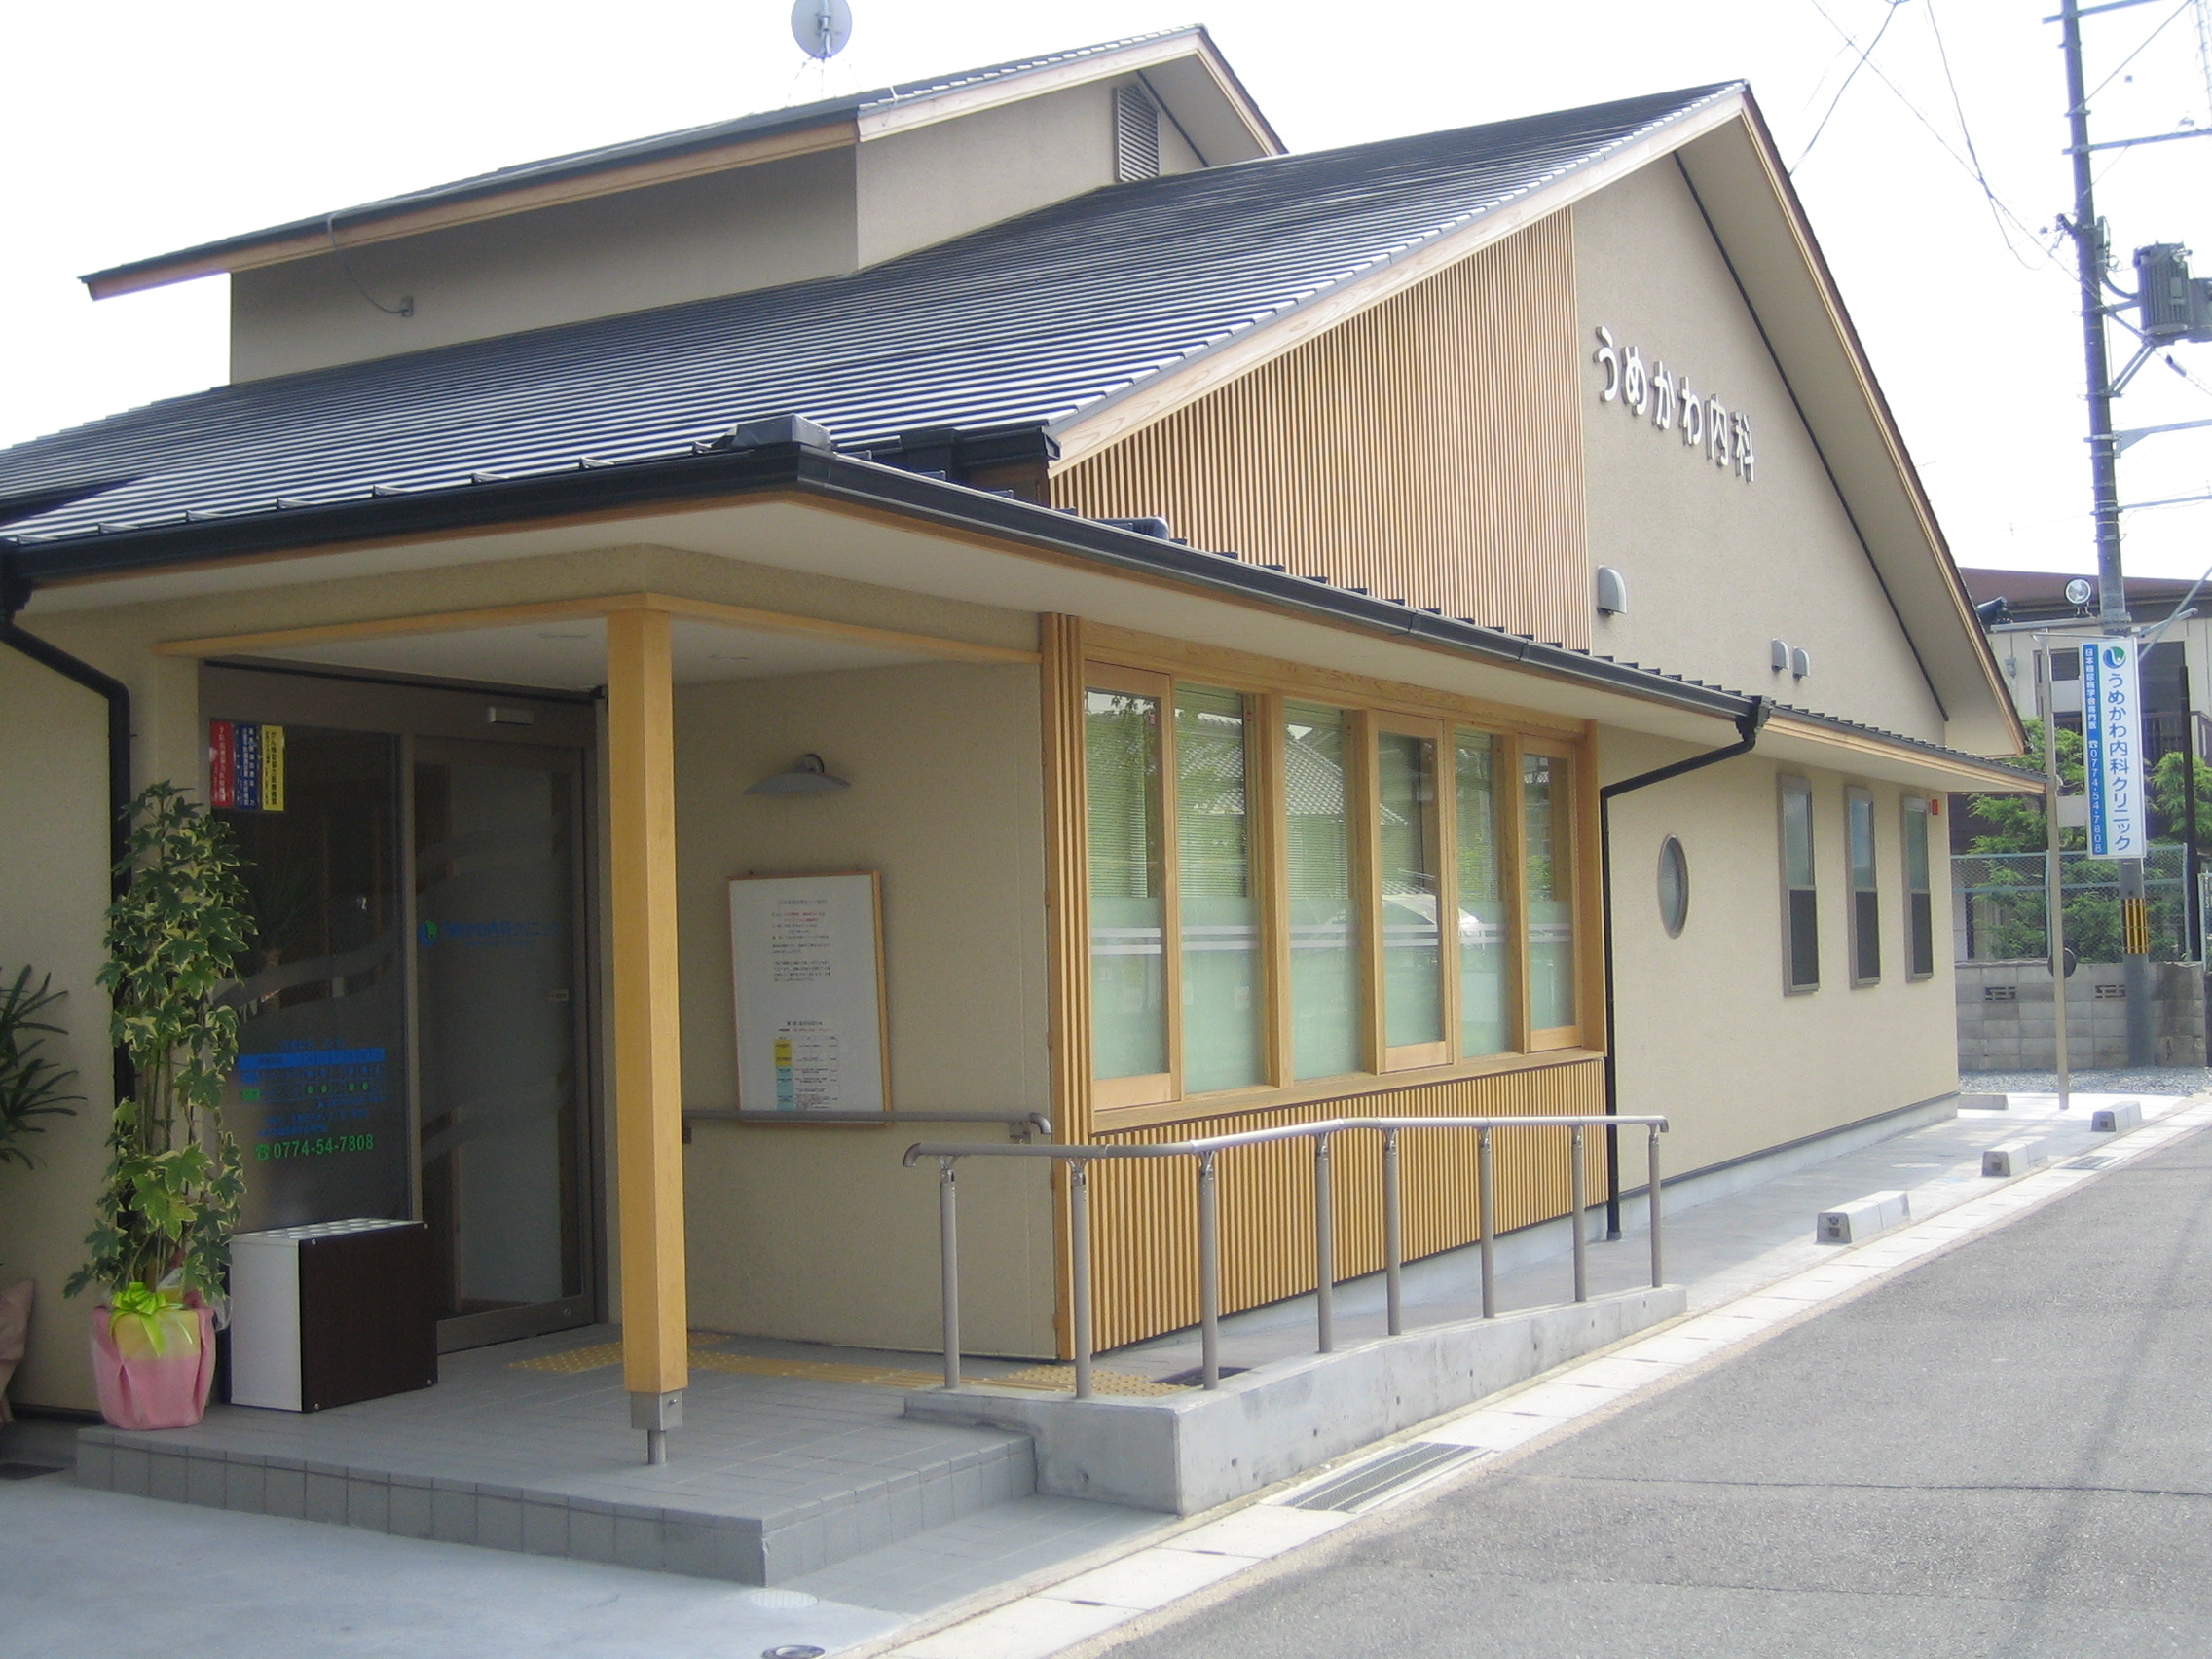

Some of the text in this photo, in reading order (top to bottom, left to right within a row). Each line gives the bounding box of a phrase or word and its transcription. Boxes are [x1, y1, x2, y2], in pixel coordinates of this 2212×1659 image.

[1593, 325, 1754, 483] うめかわ内科
[2107, 673, 2130, 851] うめかわ内科クリニック
[273, 1133, 374, 1159] 0774-54-7808
